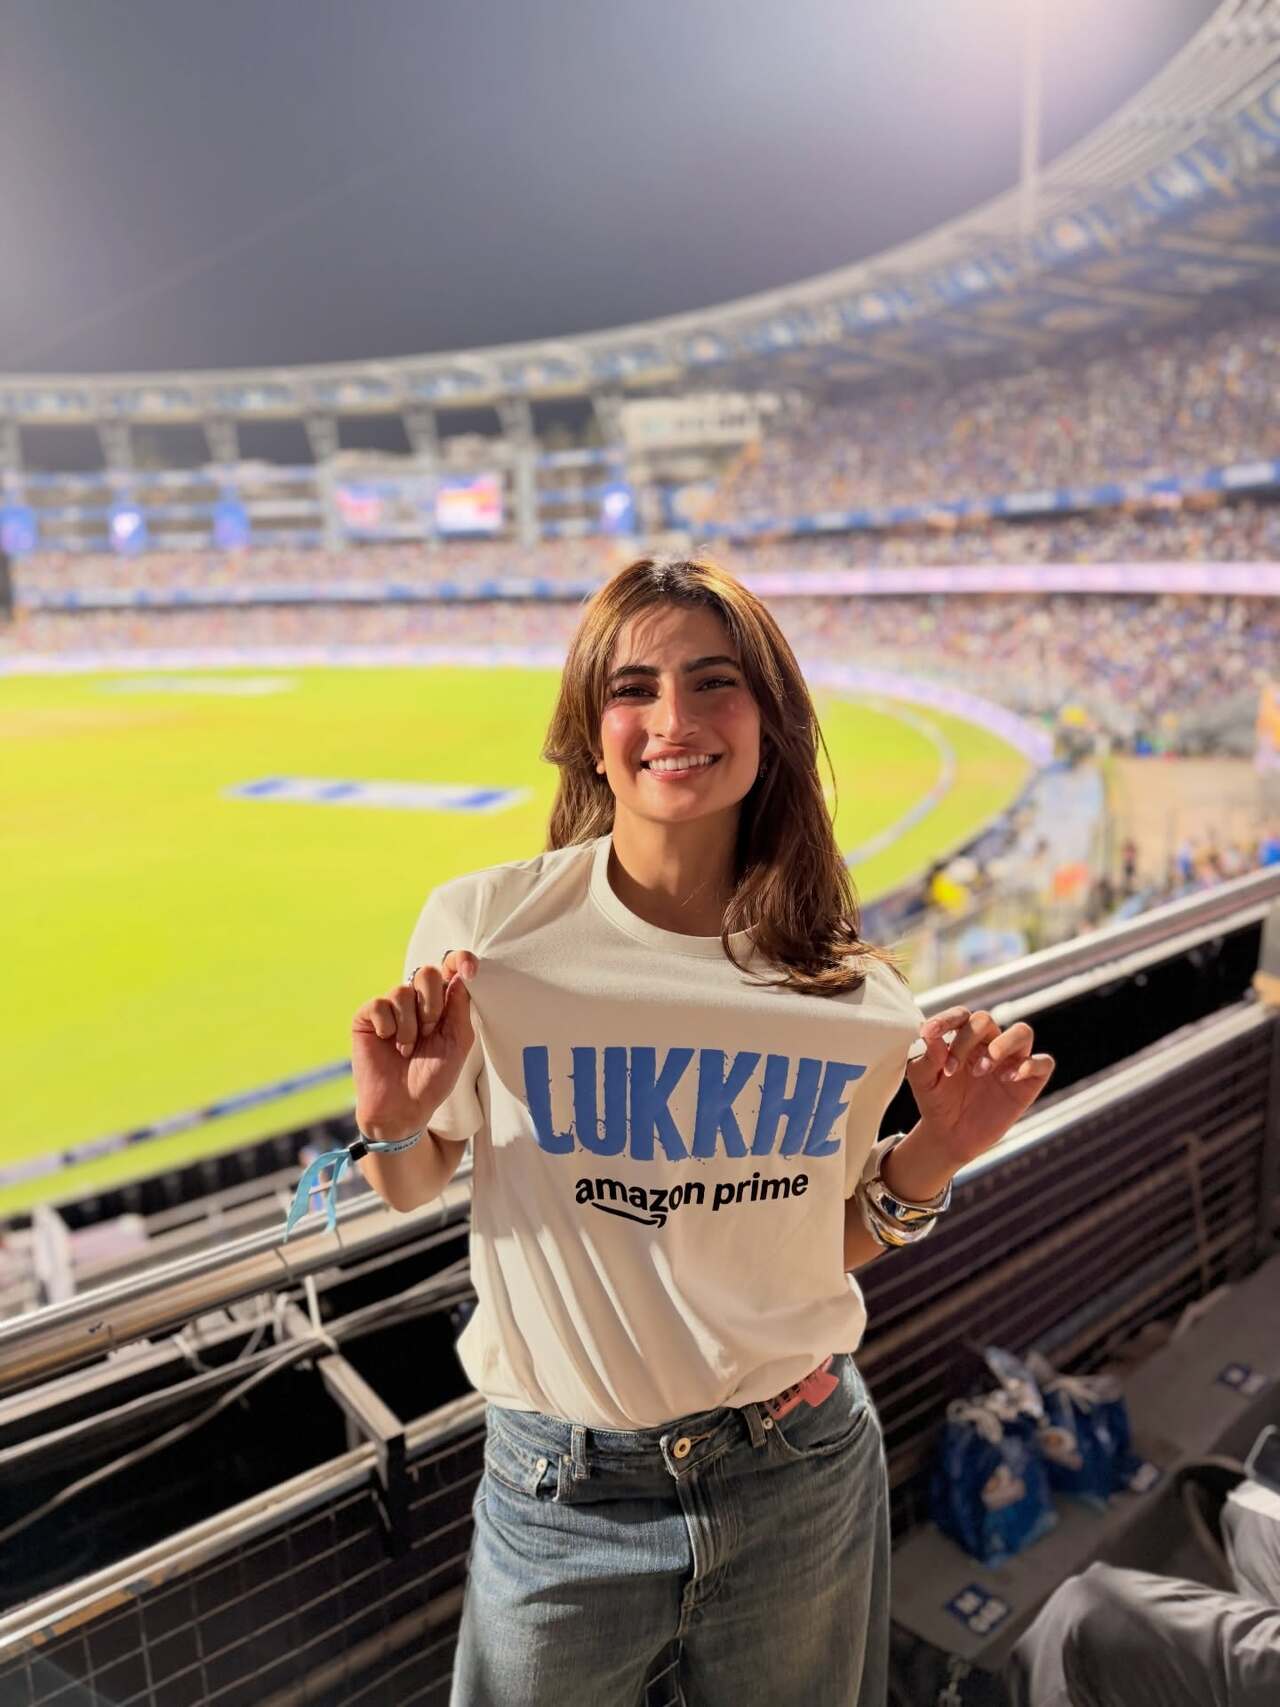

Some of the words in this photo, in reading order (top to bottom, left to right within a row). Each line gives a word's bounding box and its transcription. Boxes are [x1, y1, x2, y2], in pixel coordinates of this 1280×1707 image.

[523, 1045, 868, 1161] LUKKHE
[576, 1175, 705, 1213] amazon
[712, 1172, 809, 1211] prime
